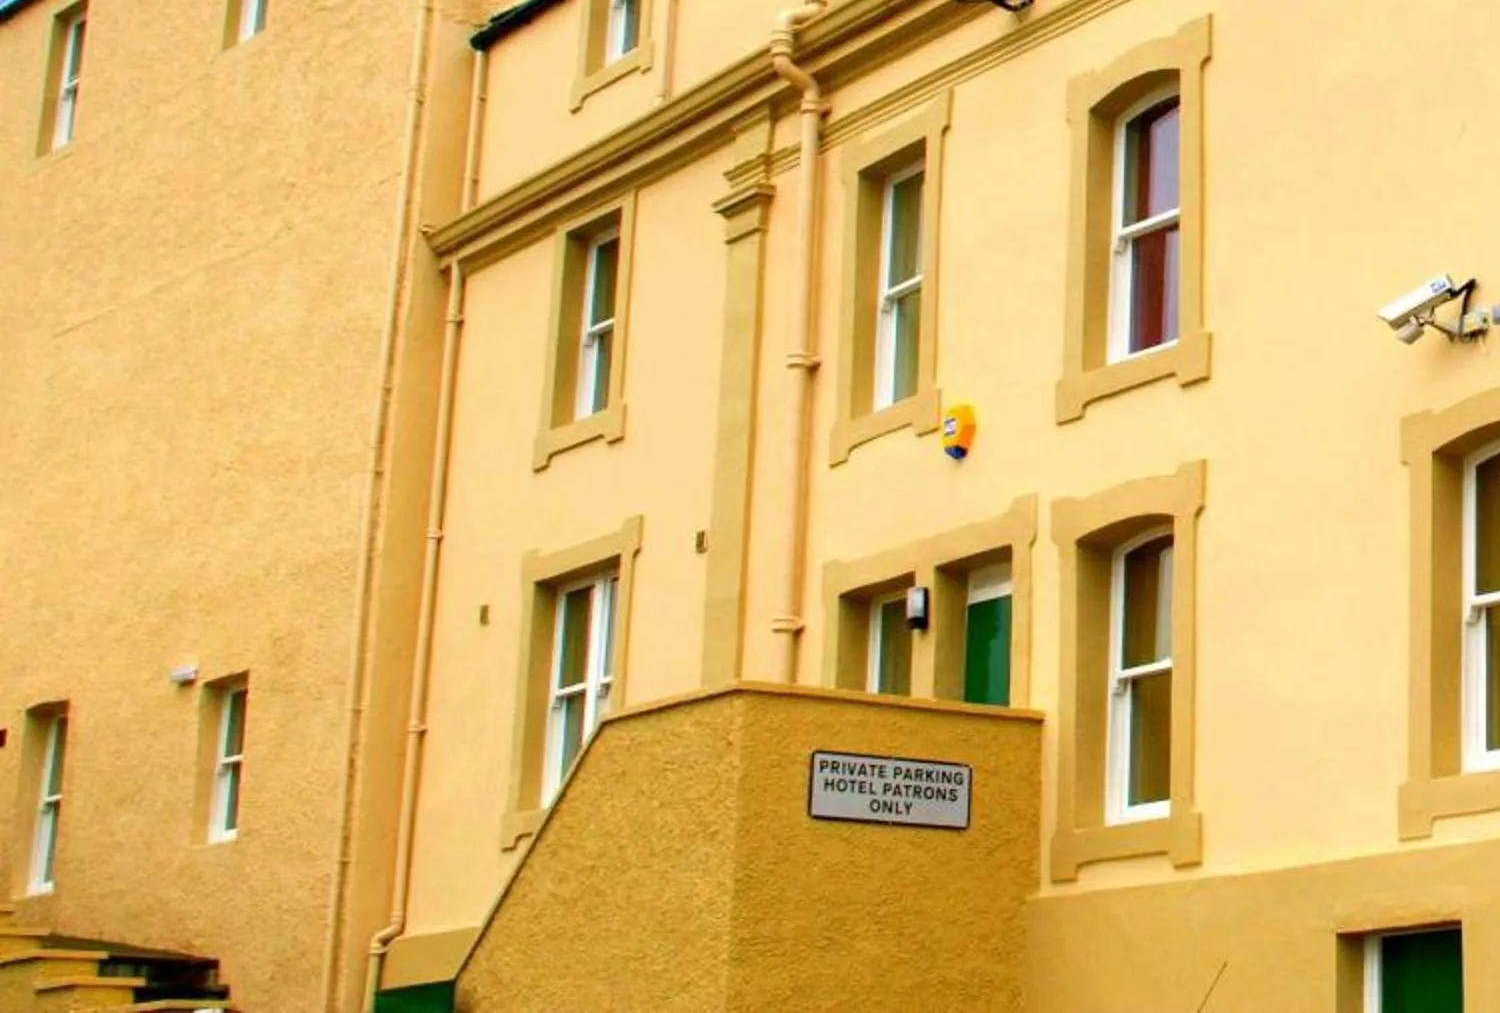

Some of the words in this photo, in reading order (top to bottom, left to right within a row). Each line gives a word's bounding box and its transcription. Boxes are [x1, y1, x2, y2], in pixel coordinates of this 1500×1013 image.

[819, 760, 888, 779] PRIVATE
[893, 766, 965, 786] PARKING
[824, 778, 877, 795] HOTEL
[882, 783, 958, 802] PATRONS
[869, 799, 913, 815] ONLY
